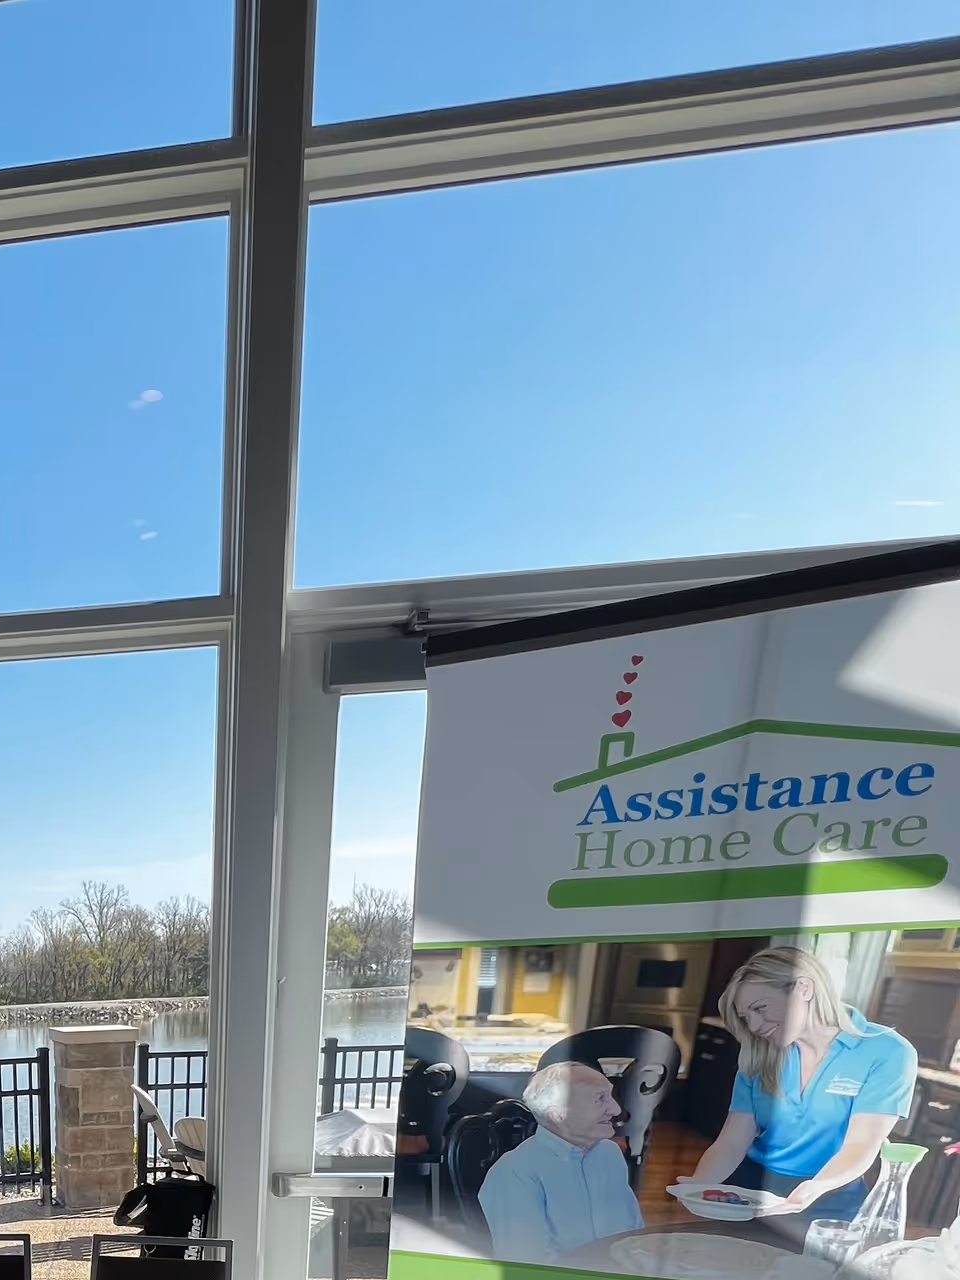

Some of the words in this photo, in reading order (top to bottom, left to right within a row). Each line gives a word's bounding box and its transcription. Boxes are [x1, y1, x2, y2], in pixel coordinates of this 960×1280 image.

[576, 763, 935, 826] Assistance
[571, 829, 752, 871] Home
[773, 812, 928, 856] Care
